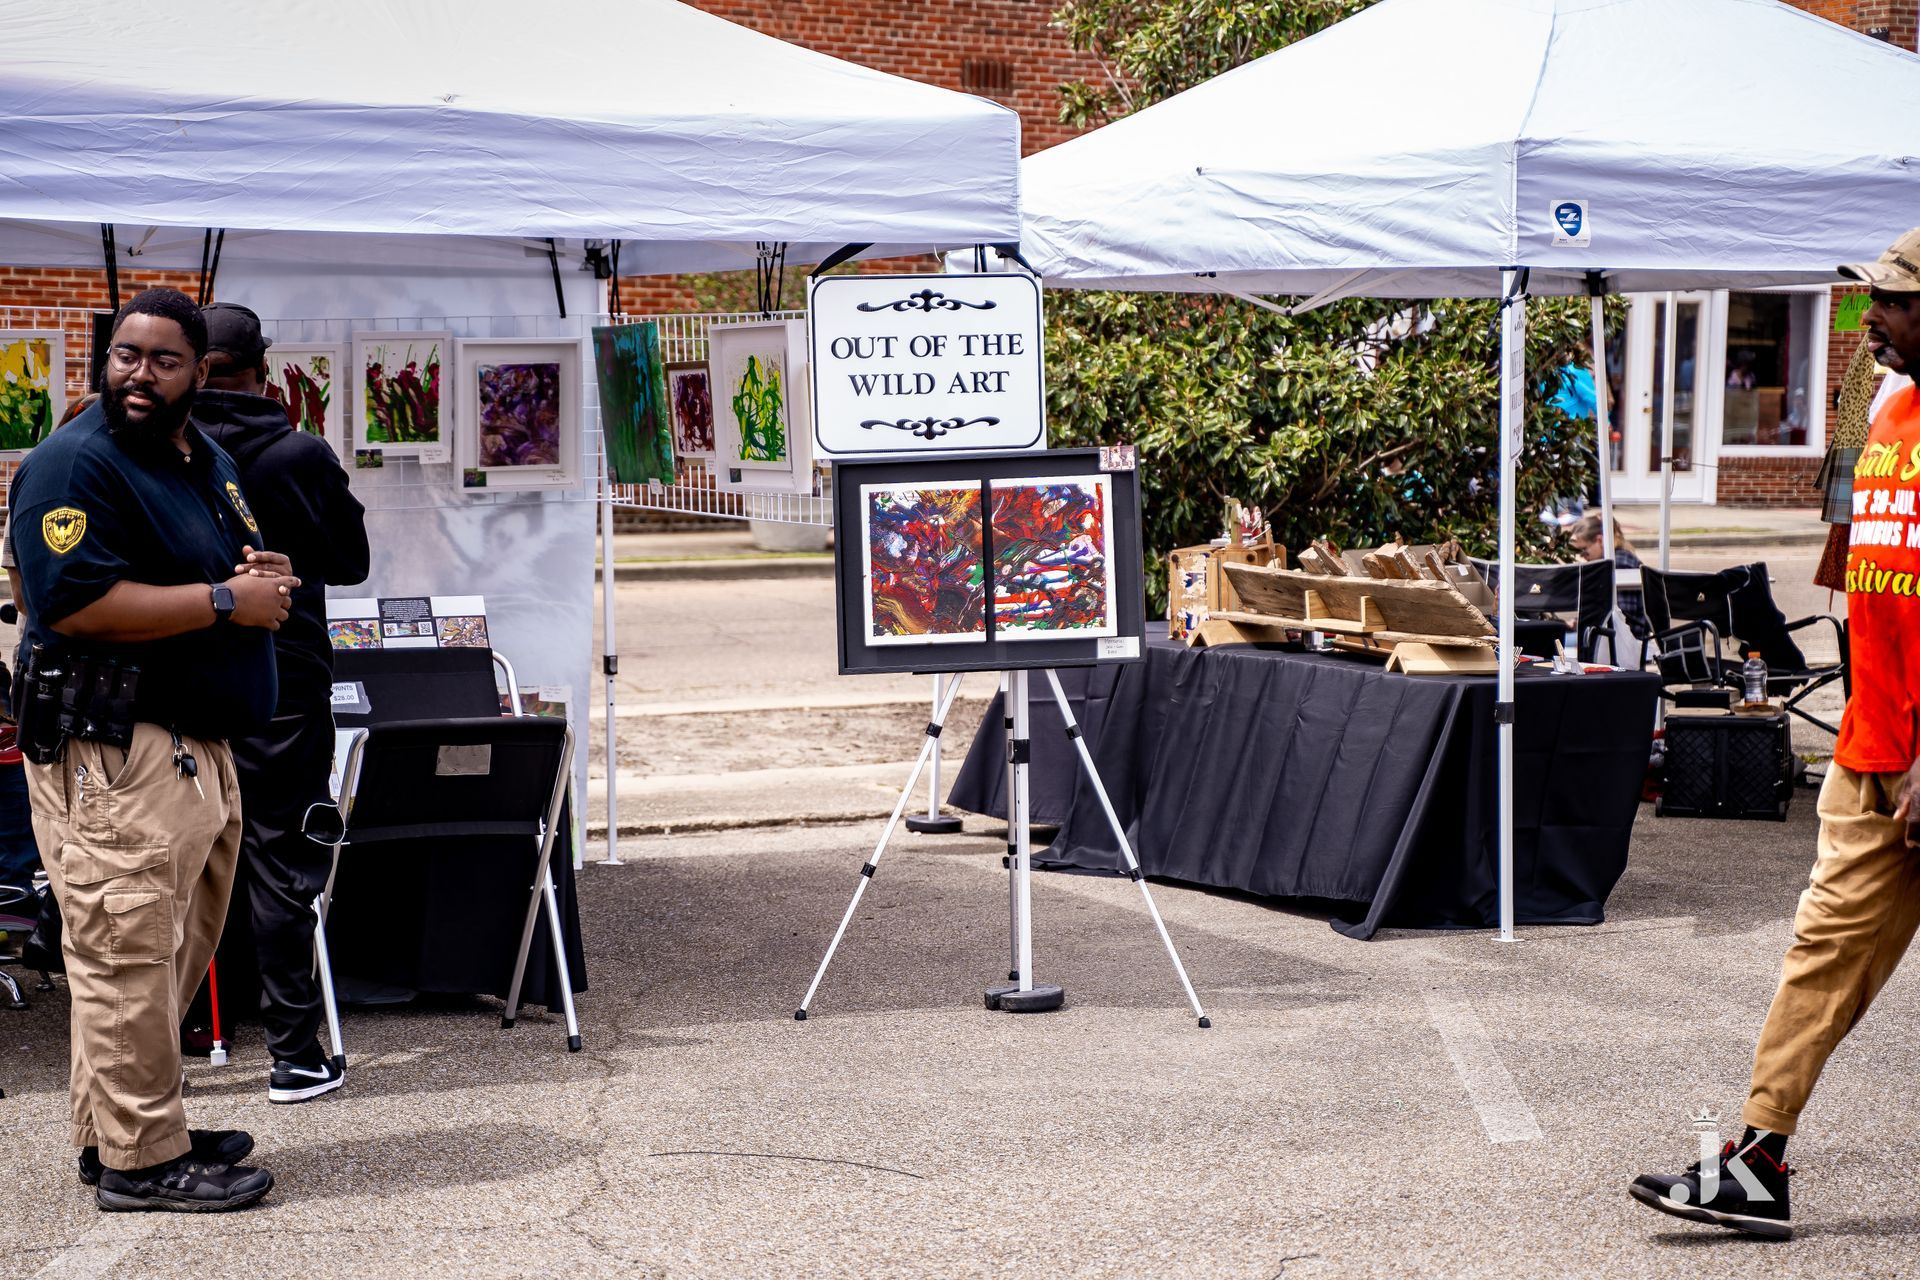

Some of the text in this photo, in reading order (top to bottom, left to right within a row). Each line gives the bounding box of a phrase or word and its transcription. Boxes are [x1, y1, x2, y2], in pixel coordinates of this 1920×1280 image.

[830, 333, 1024, 359] OUT OF THE
[848, 370, 1010, 396] WILD ART
